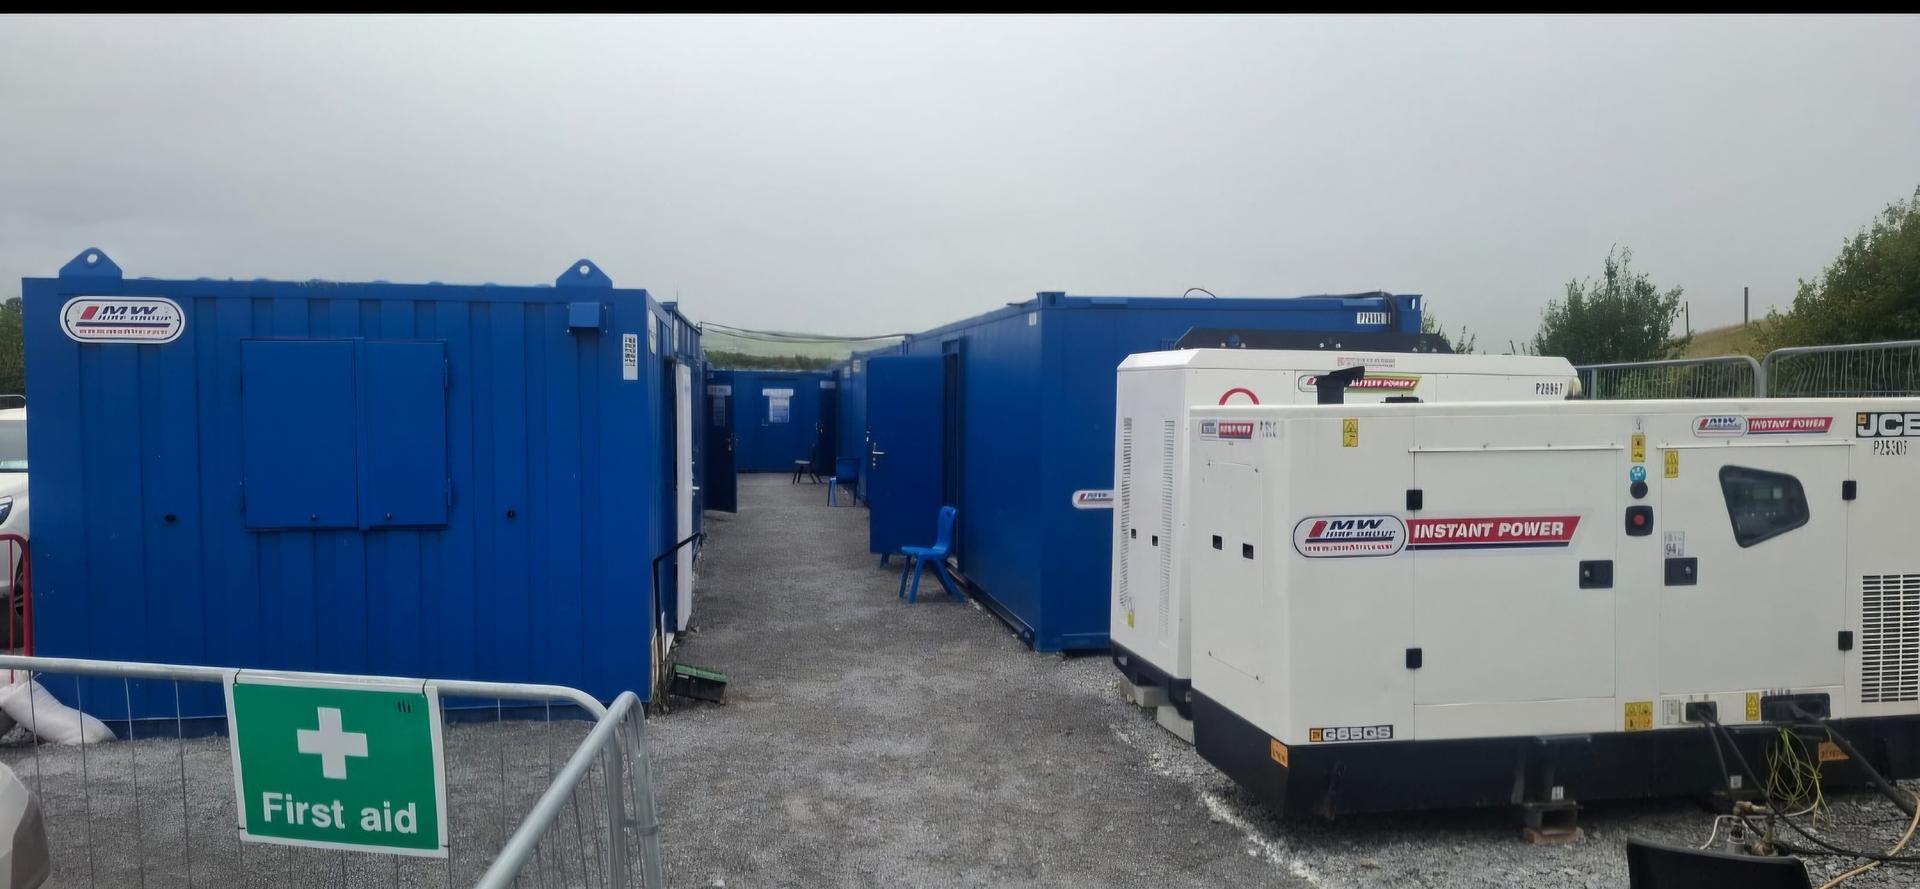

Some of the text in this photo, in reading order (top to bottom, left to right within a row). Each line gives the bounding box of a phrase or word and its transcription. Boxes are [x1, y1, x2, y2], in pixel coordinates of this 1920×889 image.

[1329, 519, 1384, 530] MW
[1414, 521, 1564, 539] INSTANT POWER
[262, 791, 418, 834] First aid
